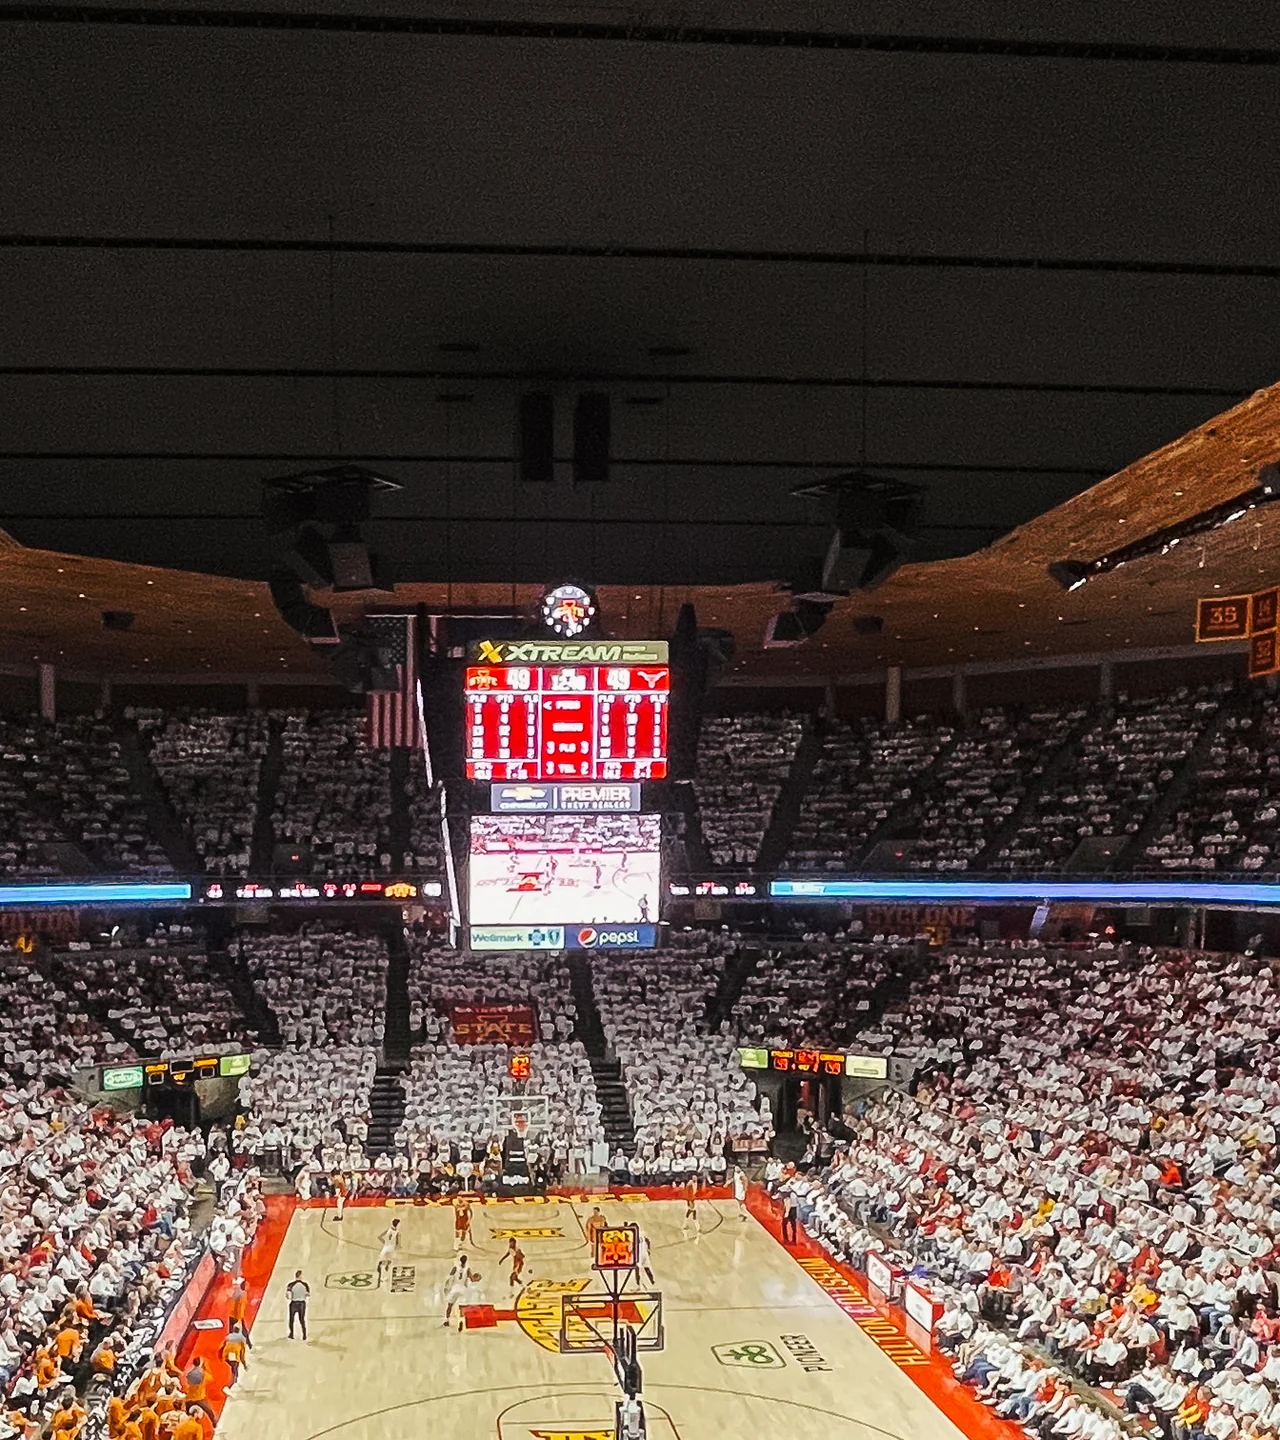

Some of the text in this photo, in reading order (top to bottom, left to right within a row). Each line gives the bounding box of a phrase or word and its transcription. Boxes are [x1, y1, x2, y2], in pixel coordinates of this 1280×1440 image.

[507, 643, 622, 661] XTREAM
[507, 669, 531, 690] 49
[606, 669, 631, 690] 49
[561, 786, 632, 801] PREMIER
[384, 882, 417, 898] STATE
[472, 933, 523, 943] Wellmark
[599, 929, 640, 947] pepsi
[455, 1023, 533, 1034] STATE
[796, 1257, 931, 1366] HILTON COLISEUM
[780, 1334, 833, 1372] PIONEER
